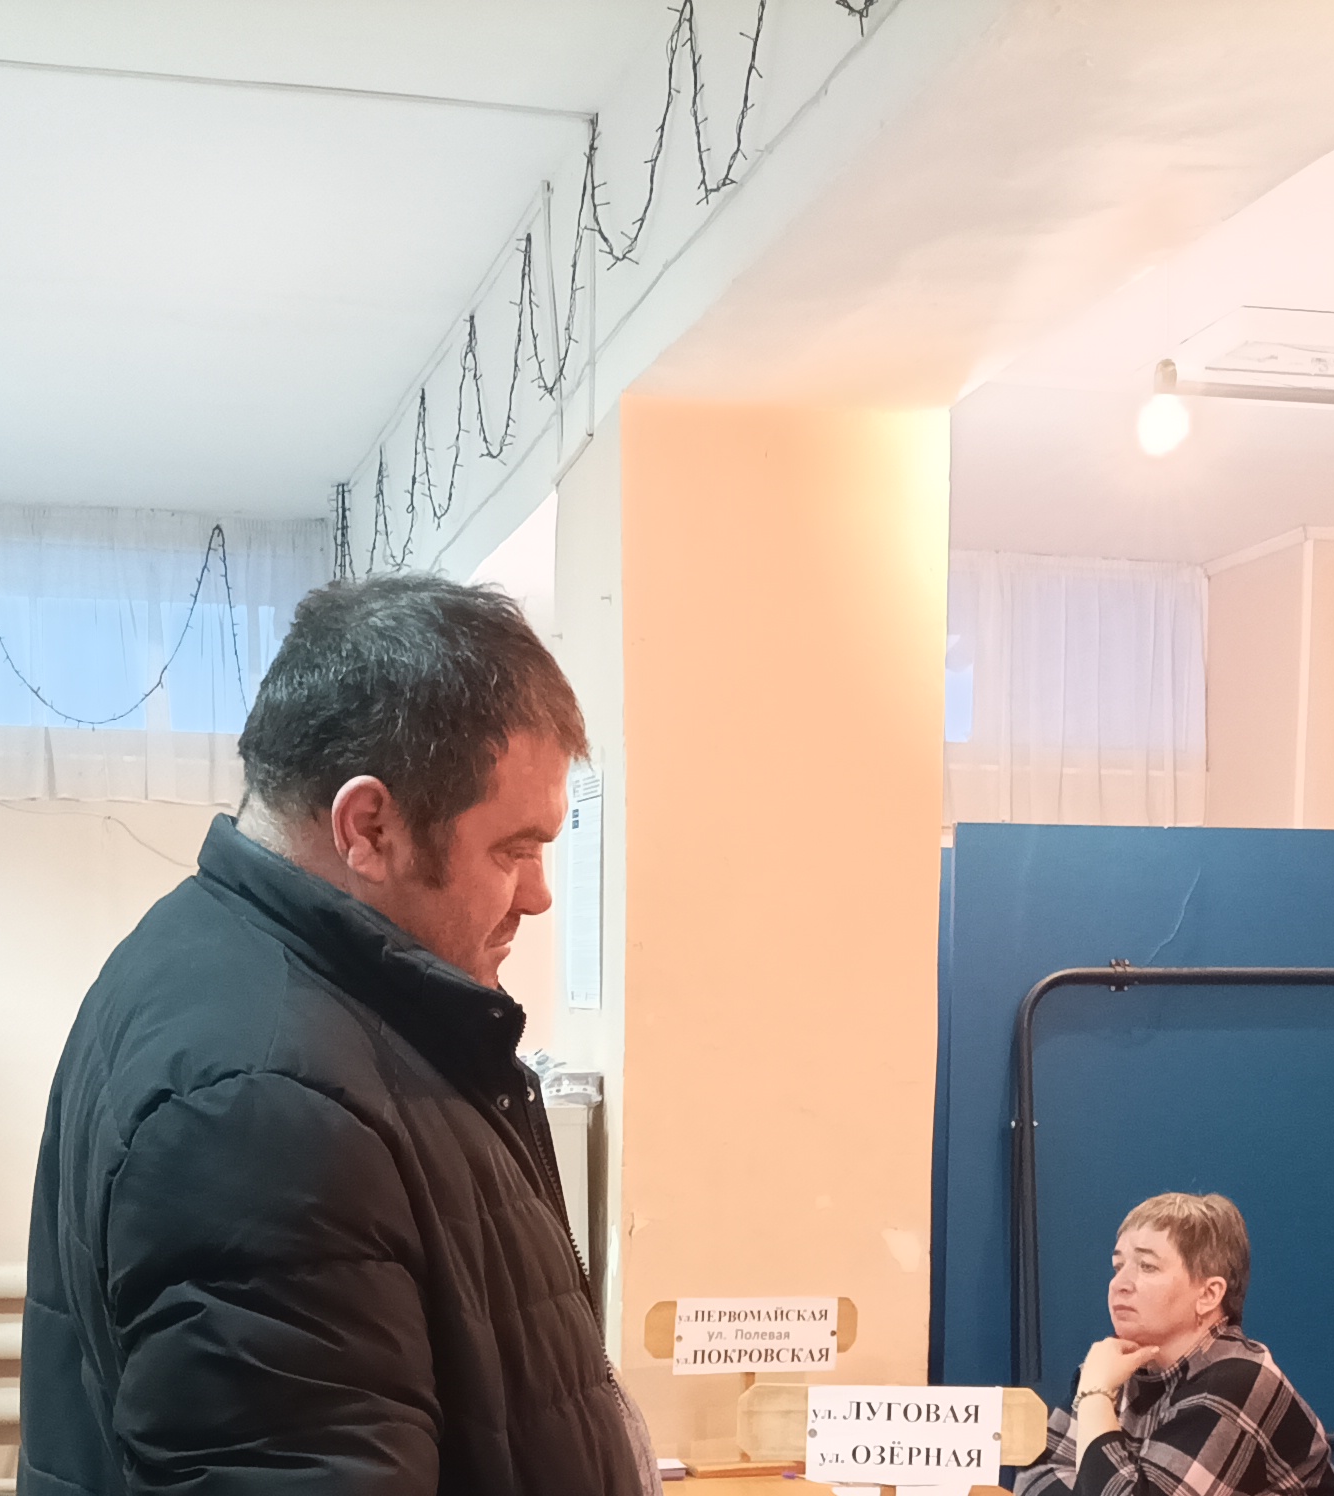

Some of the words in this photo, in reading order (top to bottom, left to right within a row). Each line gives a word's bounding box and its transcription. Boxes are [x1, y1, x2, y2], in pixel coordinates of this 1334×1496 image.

[707, 1331, 727, 1342] ул.
[735, 1329, 790, 1340] Полевая
[812, 1408, 837, 1423] ул.
[843, 1401, 980, 1424] ЛУГОВАЯ
[819, 1452, 845, 1466] ул.
[851, 1441, 982, 1467] ОЗЁРНАЯ
